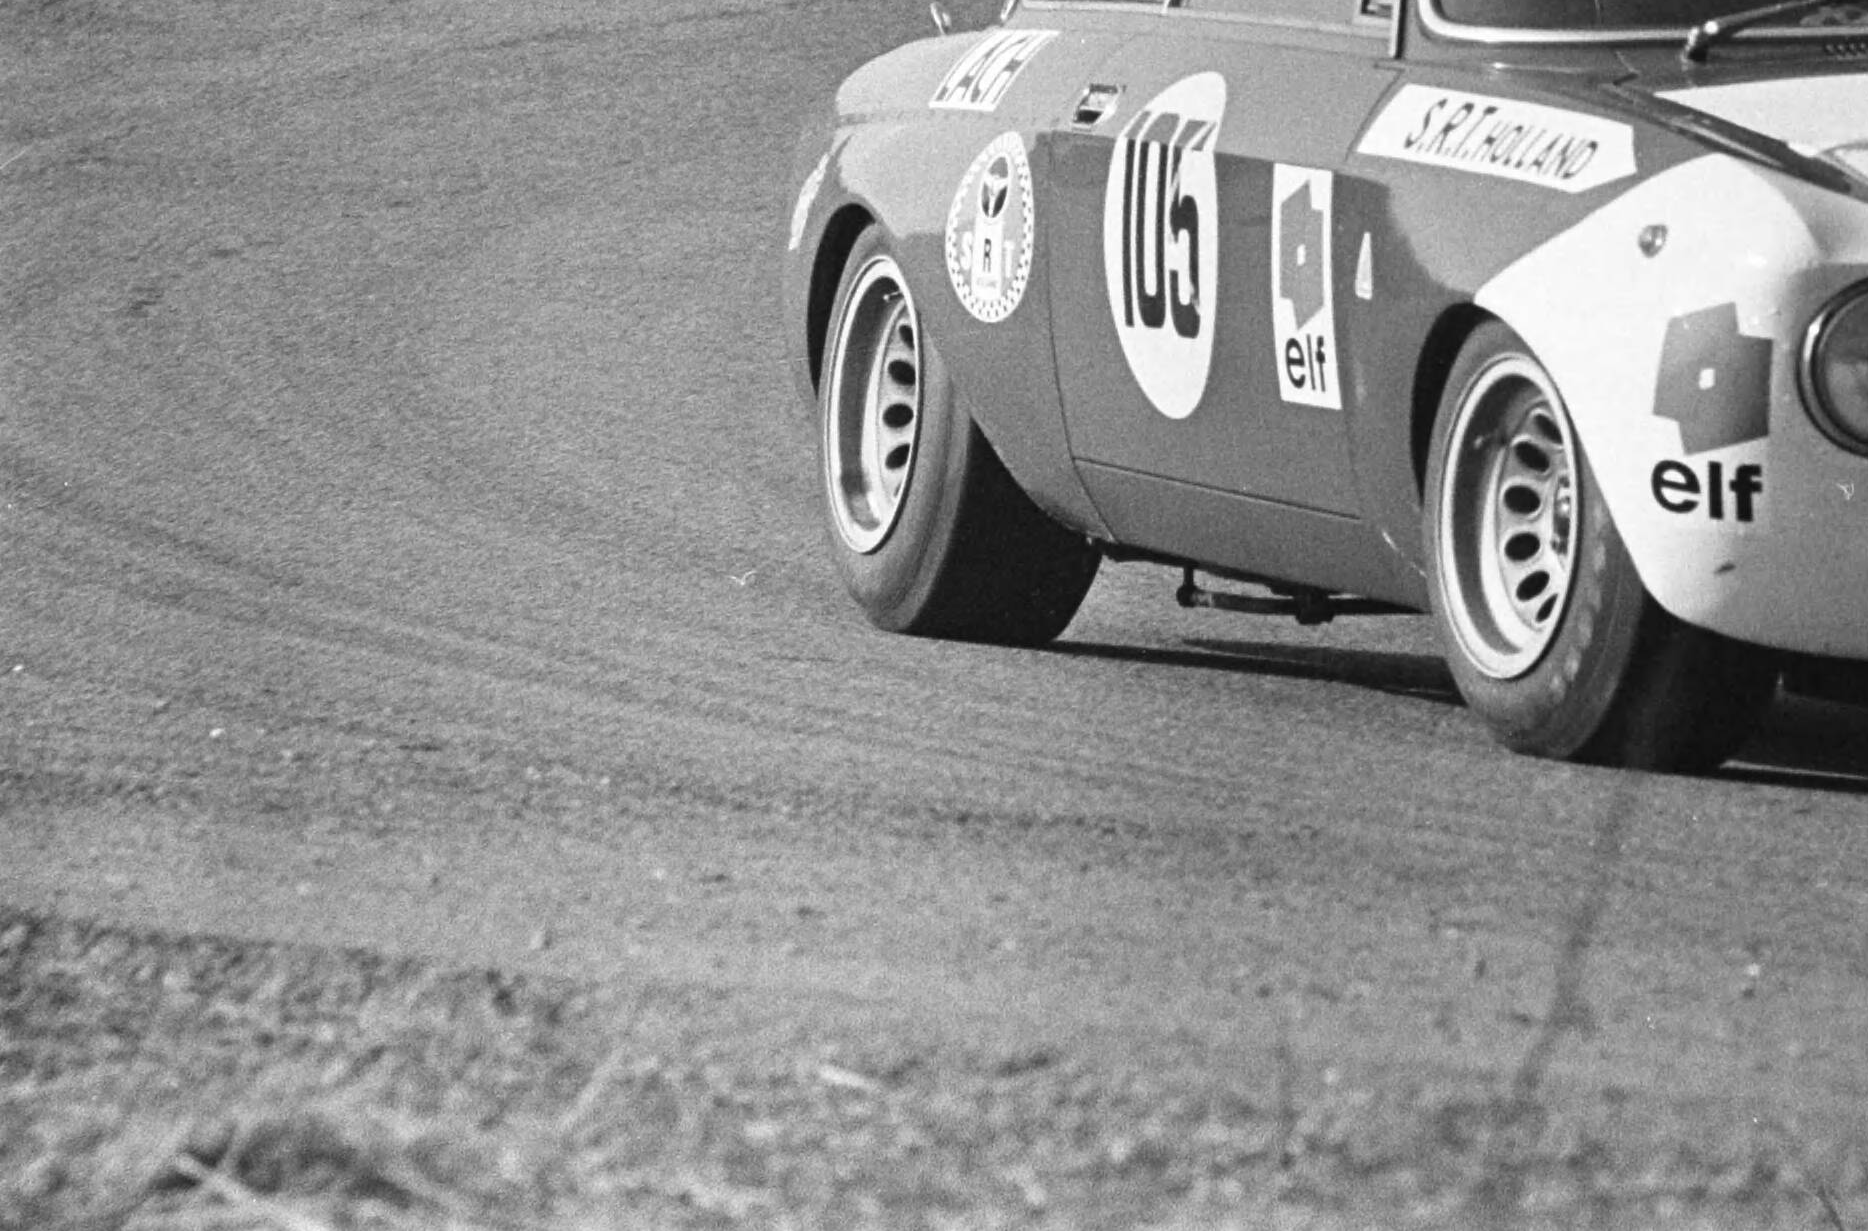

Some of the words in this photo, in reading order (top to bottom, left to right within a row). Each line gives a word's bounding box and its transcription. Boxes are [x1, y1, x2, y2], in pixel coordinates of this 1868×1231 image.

[1121, 109, 1218, 340] 105
[1284, 333, 1327, 393] elf
[1651, 459, 1763, 522] elf
